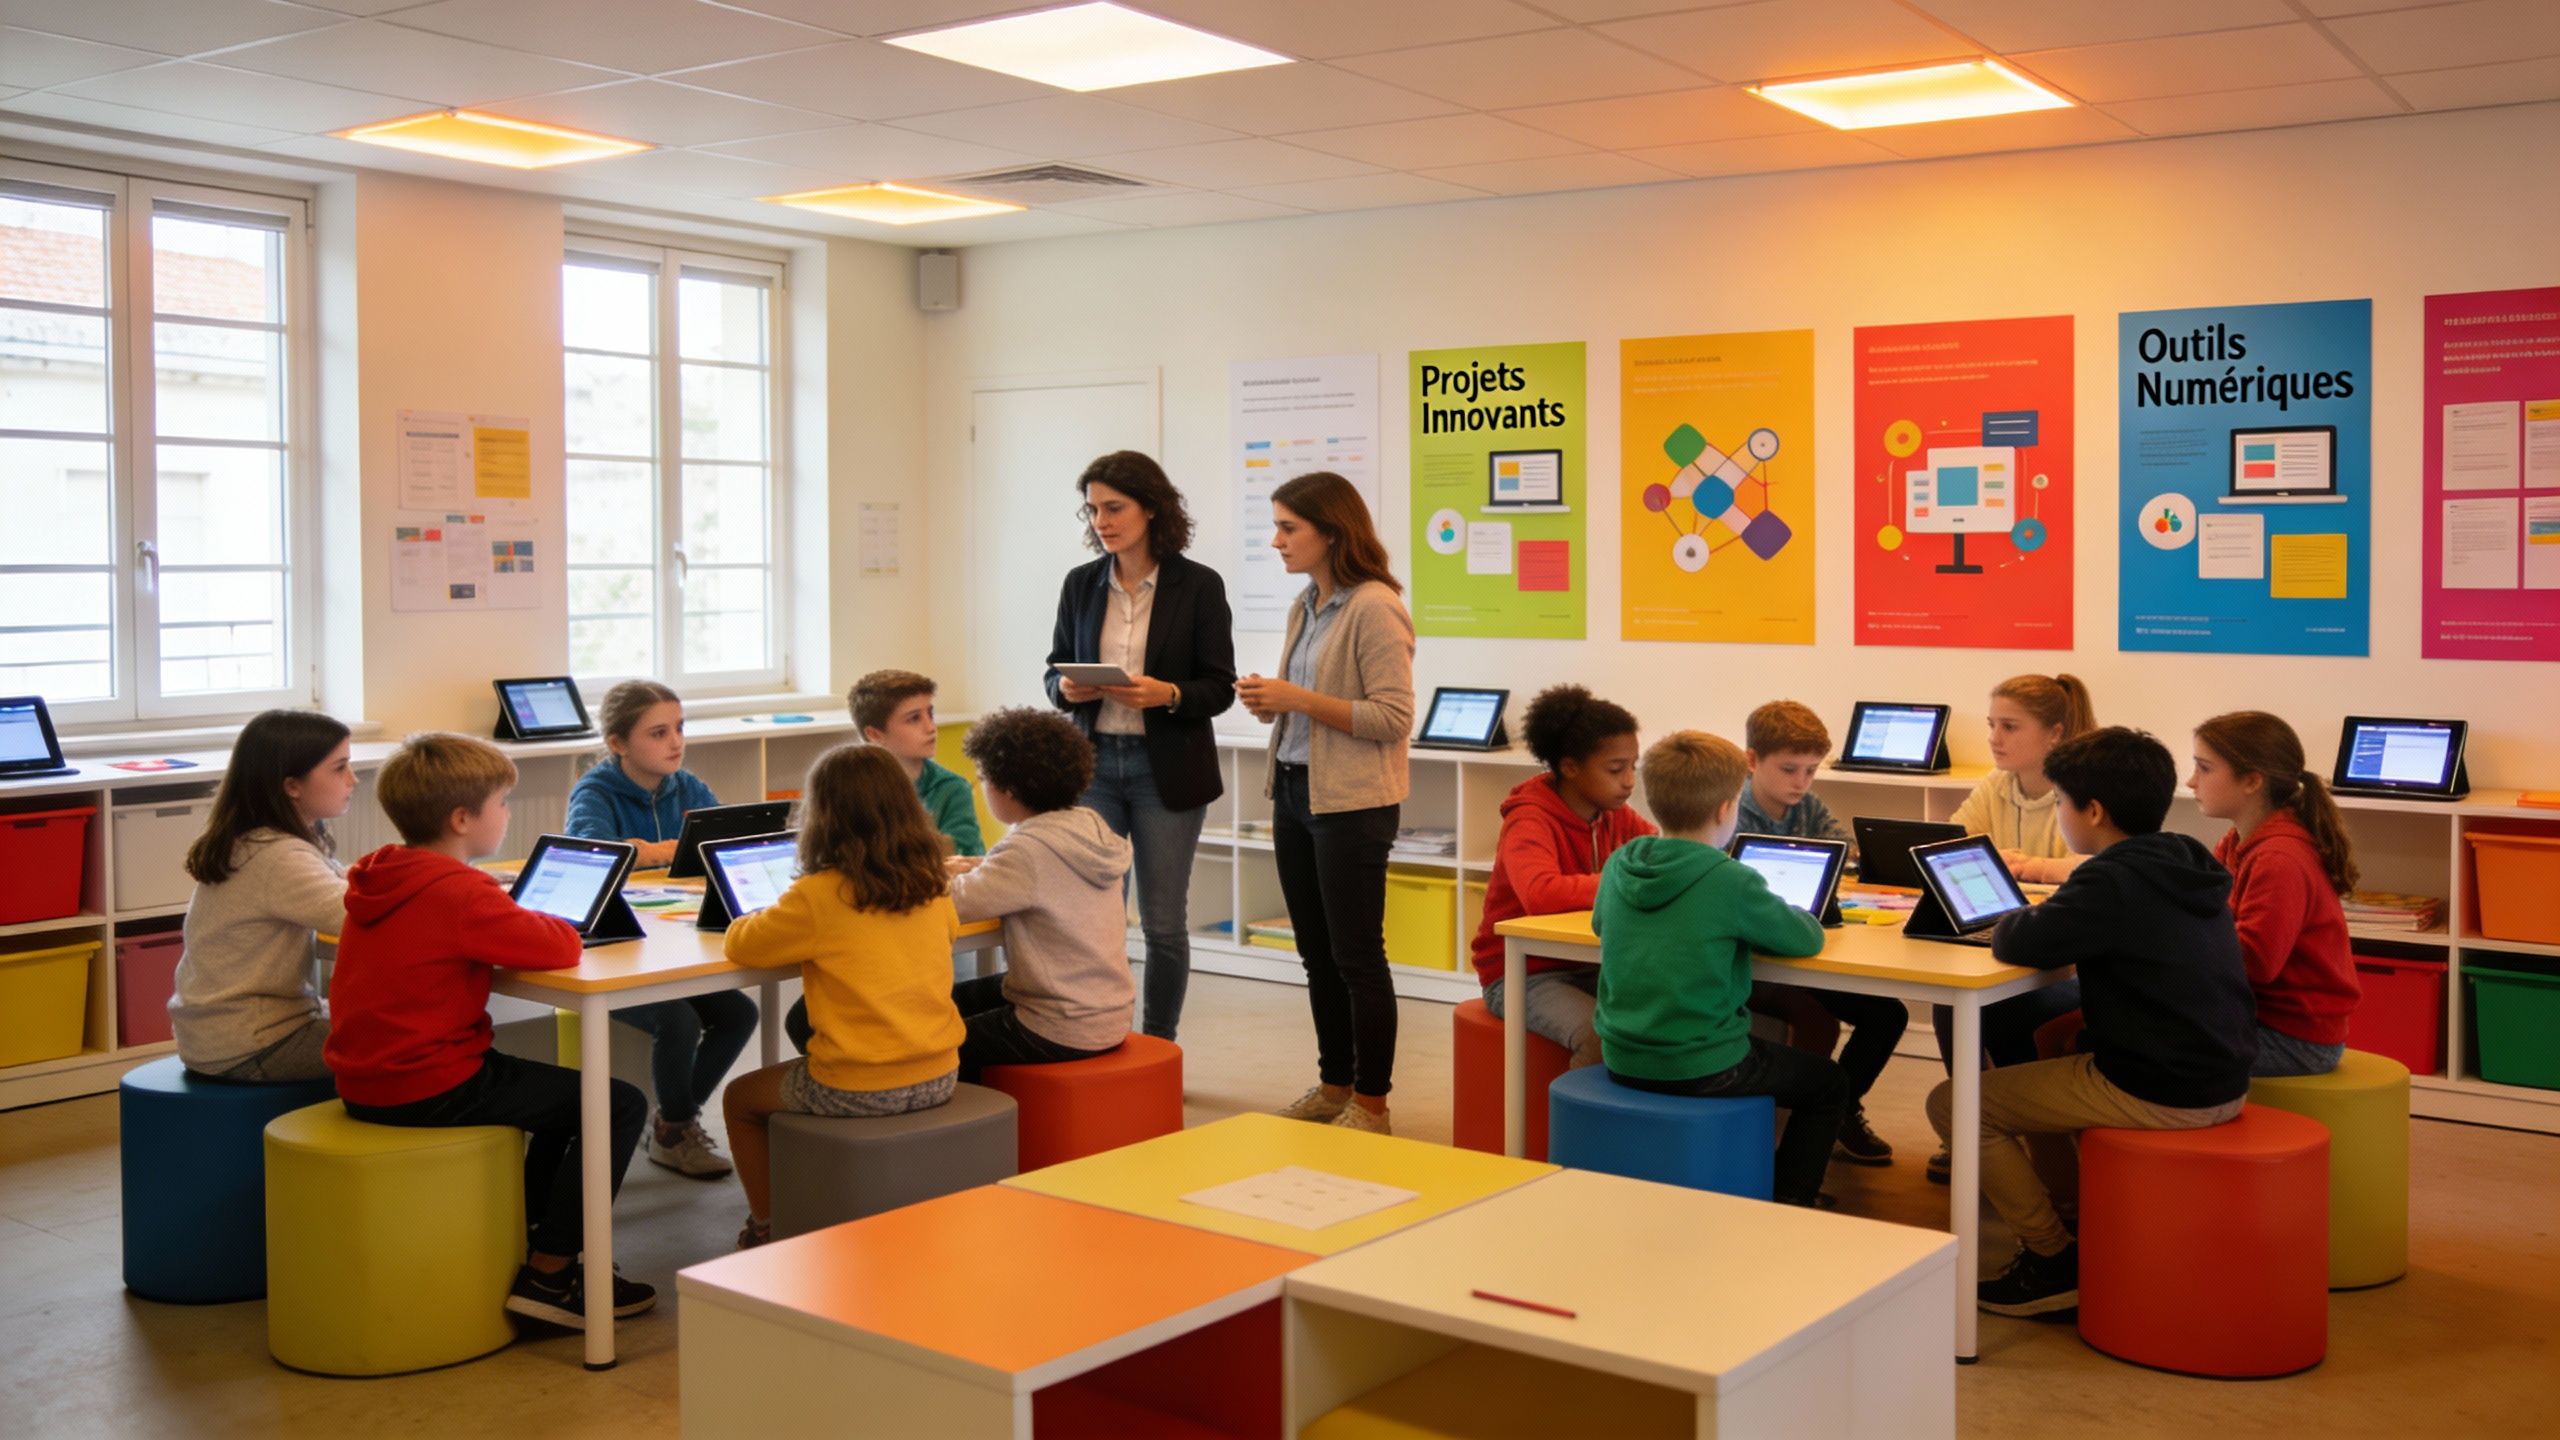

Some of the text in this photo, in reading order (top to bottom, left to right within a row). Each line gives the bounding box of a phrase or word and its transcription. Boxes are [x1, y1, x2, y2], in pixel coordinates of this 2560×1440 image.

[2138, 323, 2247, 363] Outils
[1421, 361, 1526, 403] Projets
[2137, 366, 2354, 411] Numériques
[1422, 397, 1566, 434] Innovants
